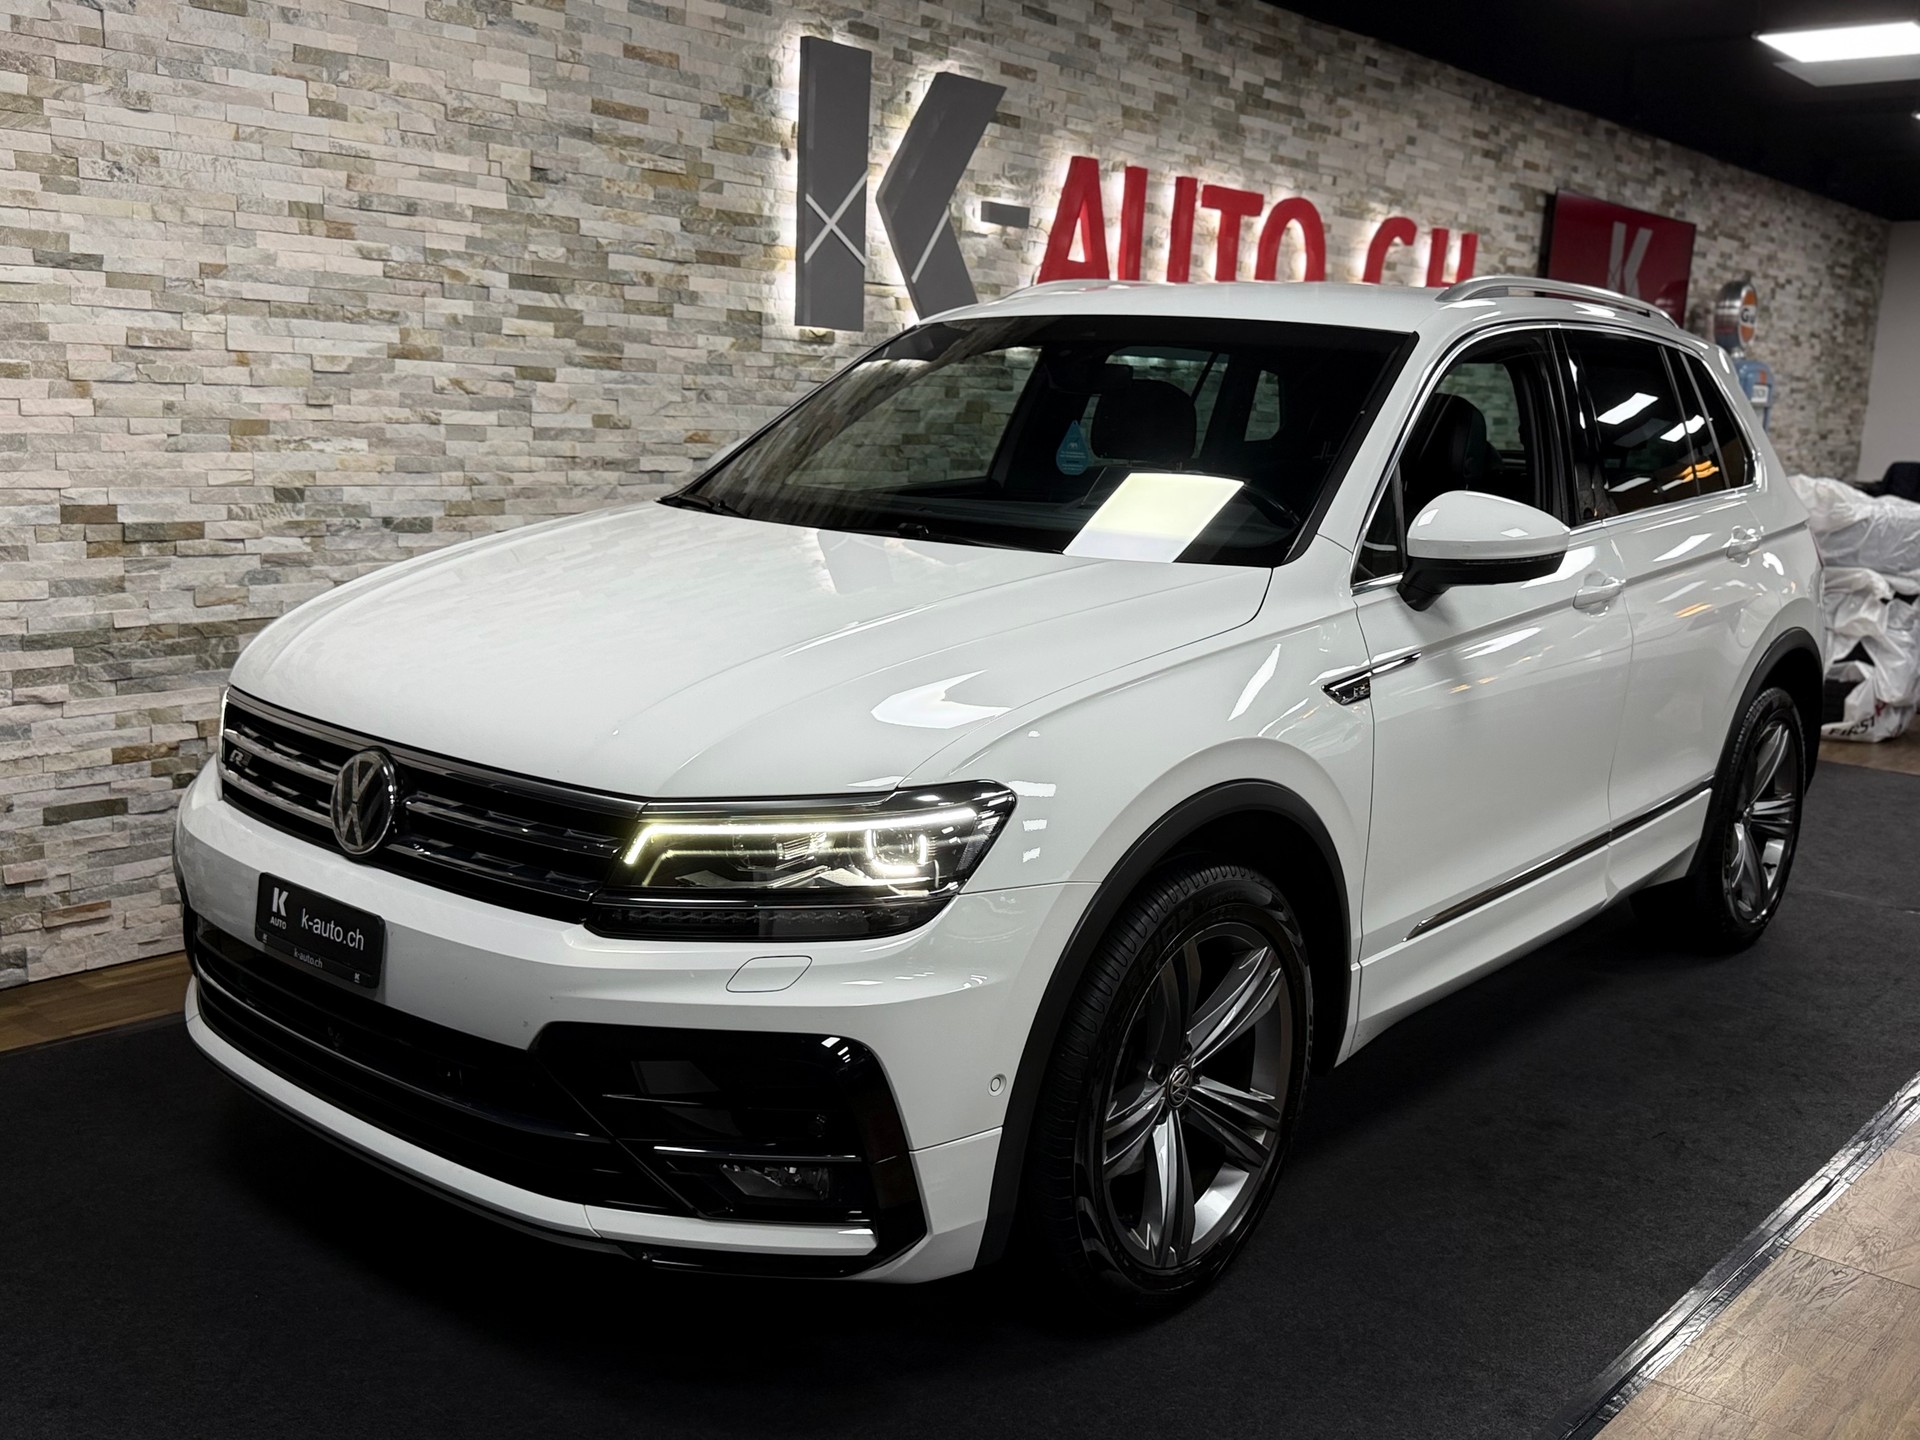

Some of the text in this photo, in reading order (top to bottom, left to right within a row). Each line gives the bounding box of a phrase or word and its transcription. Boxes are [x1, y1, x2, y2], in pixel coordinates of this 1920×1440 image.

[795, 35, 1478, 331] K-AUTOCH
[272, 887, 289, 917] K
[270, 916, 287, 930] AUTO
[301, 907, 365, 951] k-auto.ch
[293, 947, 323, 968] k-auto.ch
